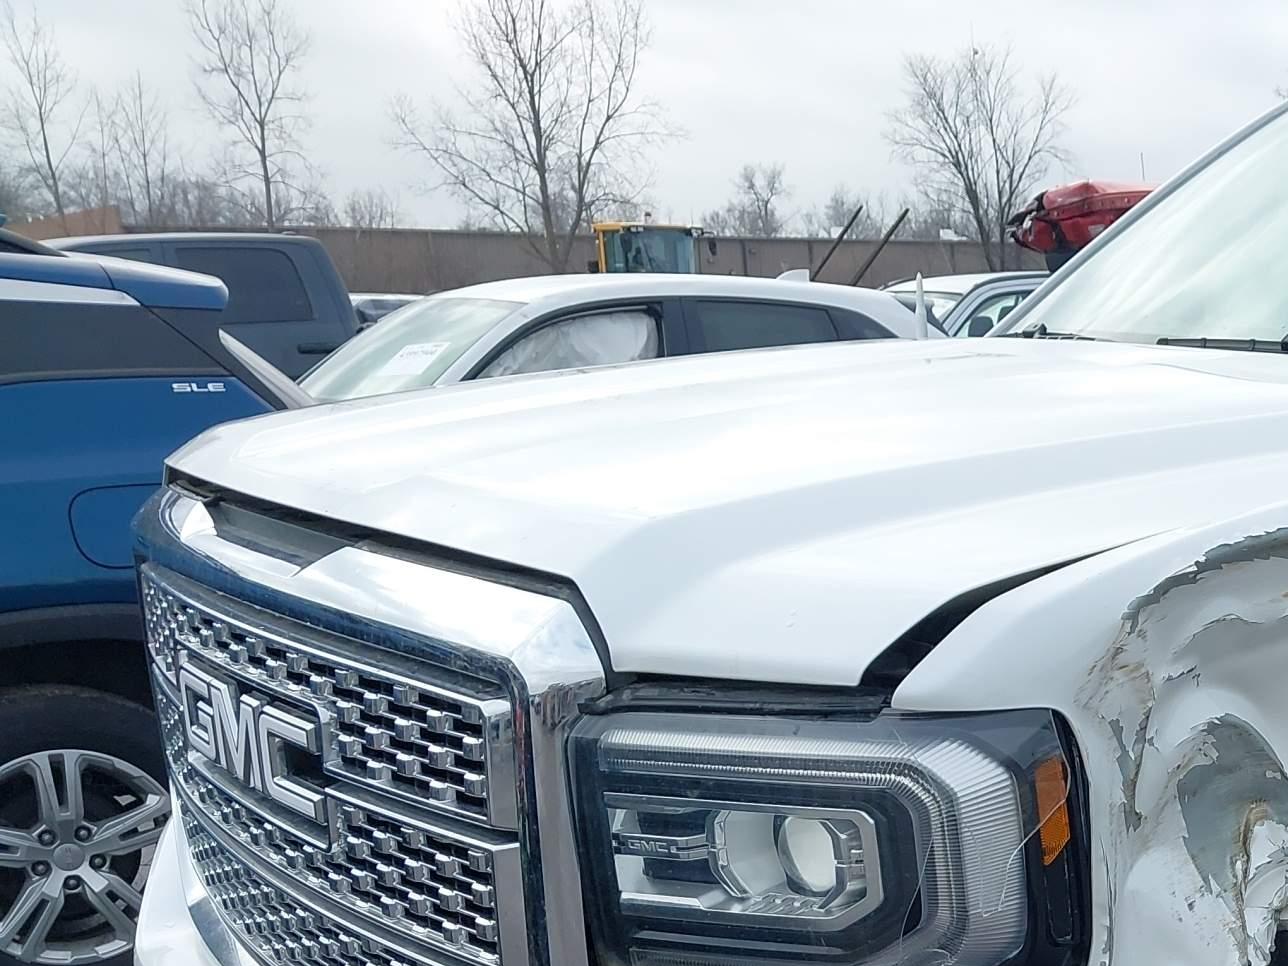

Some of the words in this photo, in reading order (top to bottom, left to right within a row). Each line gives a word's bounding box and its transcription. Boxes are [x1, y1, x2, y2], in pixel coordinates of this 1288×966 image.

[171, 382, 227, 393] SLE
[178, 660, 329, 826] GMC
[627, 839, 669, 853] GMC
